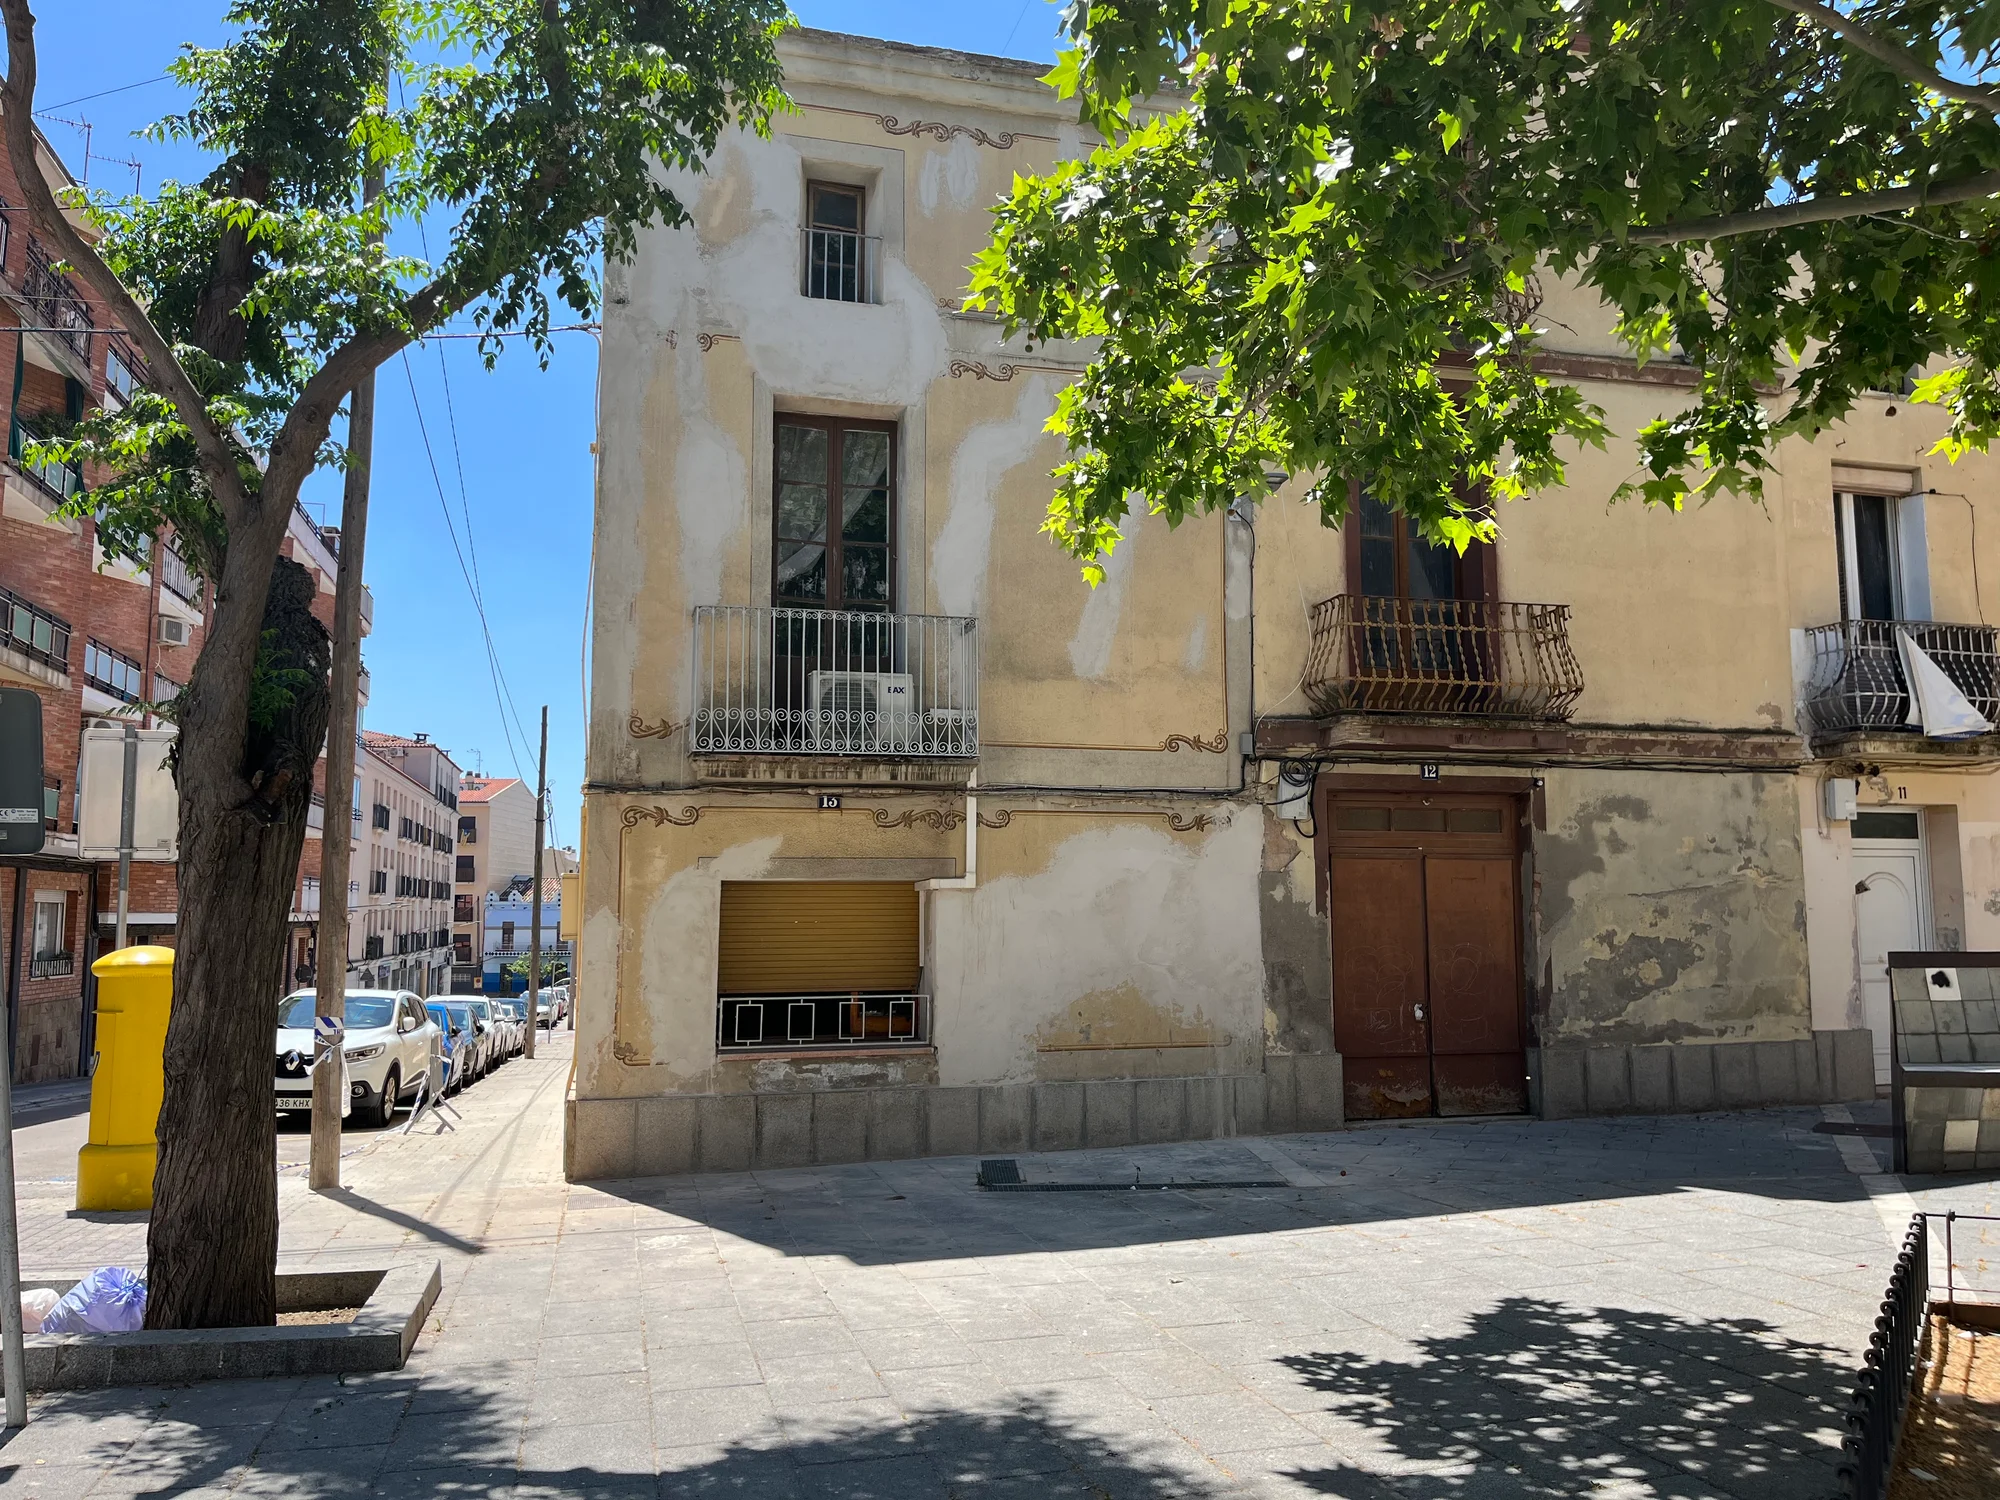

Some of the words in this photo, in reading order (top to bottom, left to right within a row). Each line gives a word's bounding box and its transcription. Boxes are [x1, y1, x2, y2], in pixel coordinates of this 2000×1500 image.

[1423, 764, 1437, 778] 12
[1897, 786, 1907, 799] 11
[292, 1099, 310, 1108] KHX
